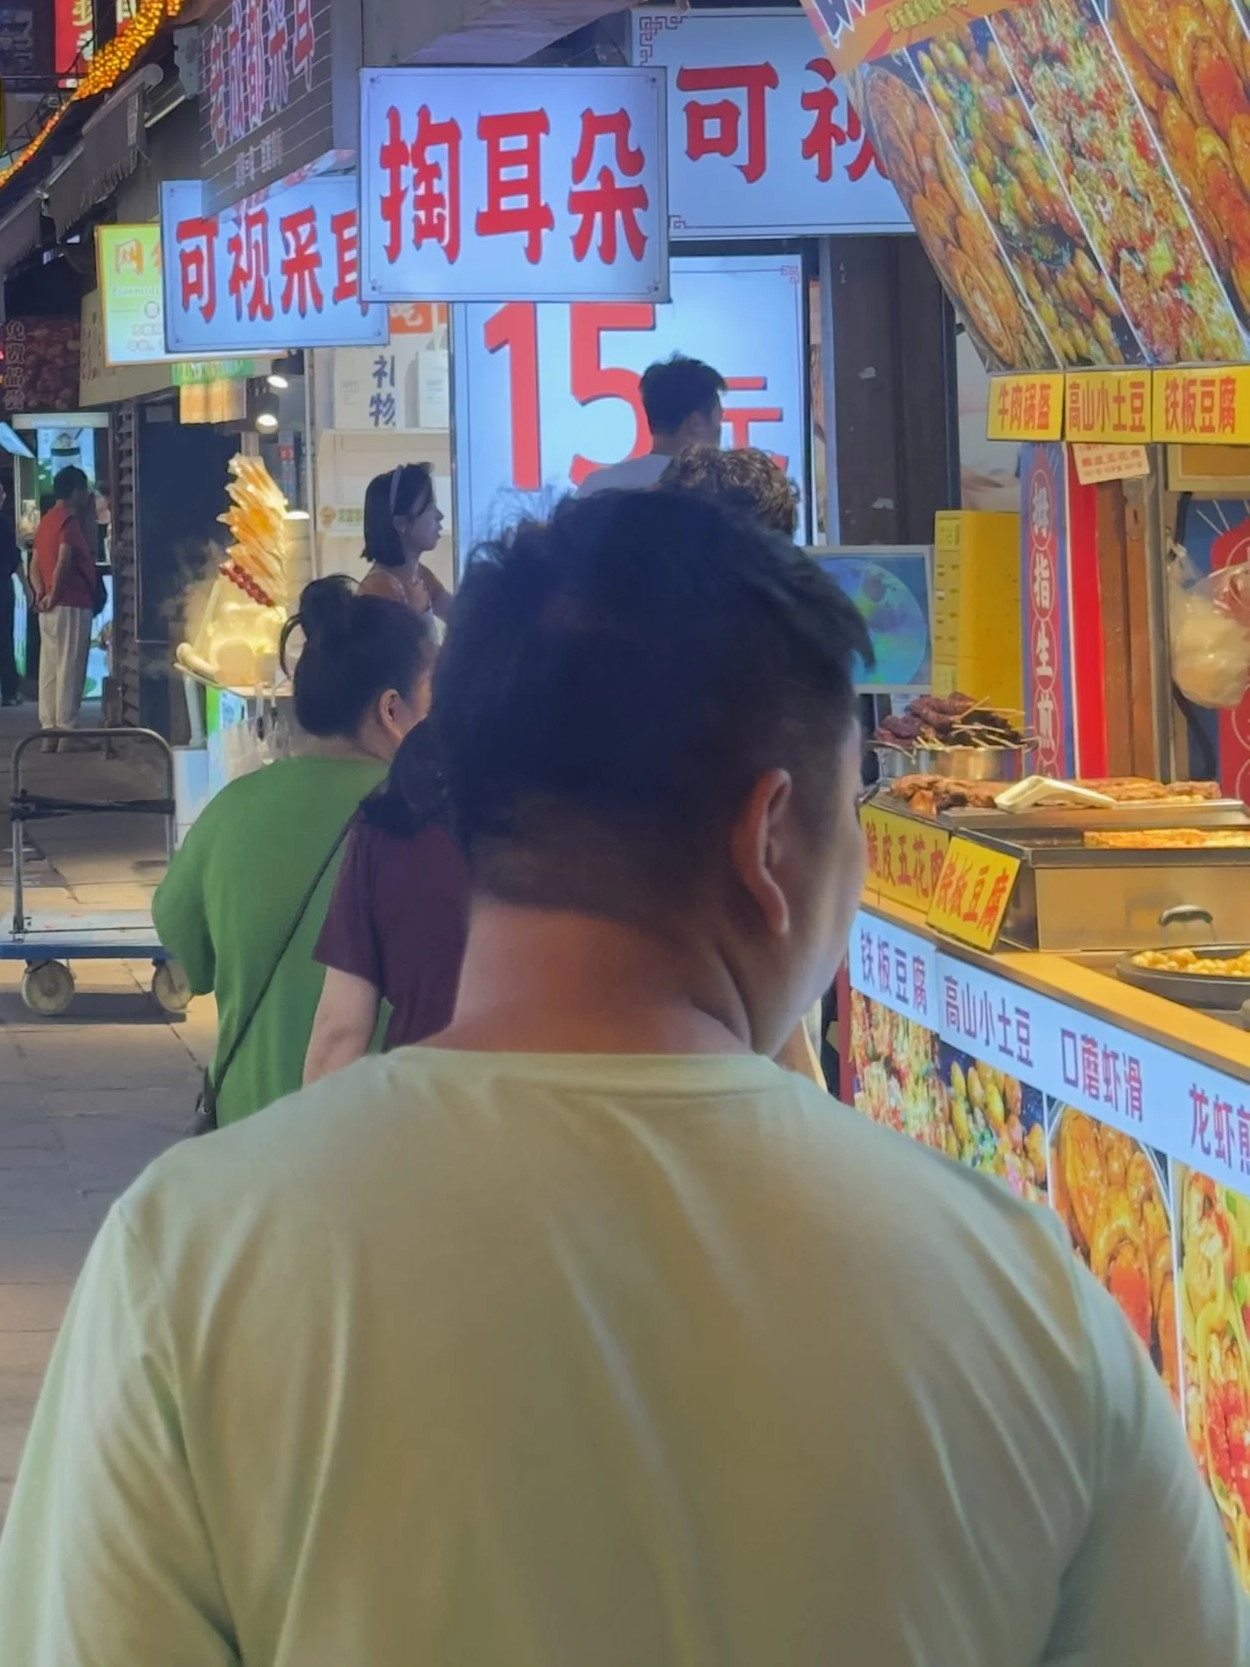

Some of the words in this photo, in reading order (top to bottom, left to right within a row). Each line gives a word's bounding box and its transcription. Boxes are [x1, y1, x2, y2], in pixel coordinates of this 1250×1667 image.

[380, 104, 649, 265] 掏耳朵
[369, 354, 397, 427] 礼物
[1069, 378, 1146, 433] 高山小土豆
[1164, 375, 1237, 435] 铁板豆腐
[936, 852, 1010, 938] 铁板豆腐
[860, 927, 927, 1016] 铁板豆腐
[944, 974, 1034, 1069] 高山小土豆
[1060, 1027, 1144, 1123] 口蘑虾滑
